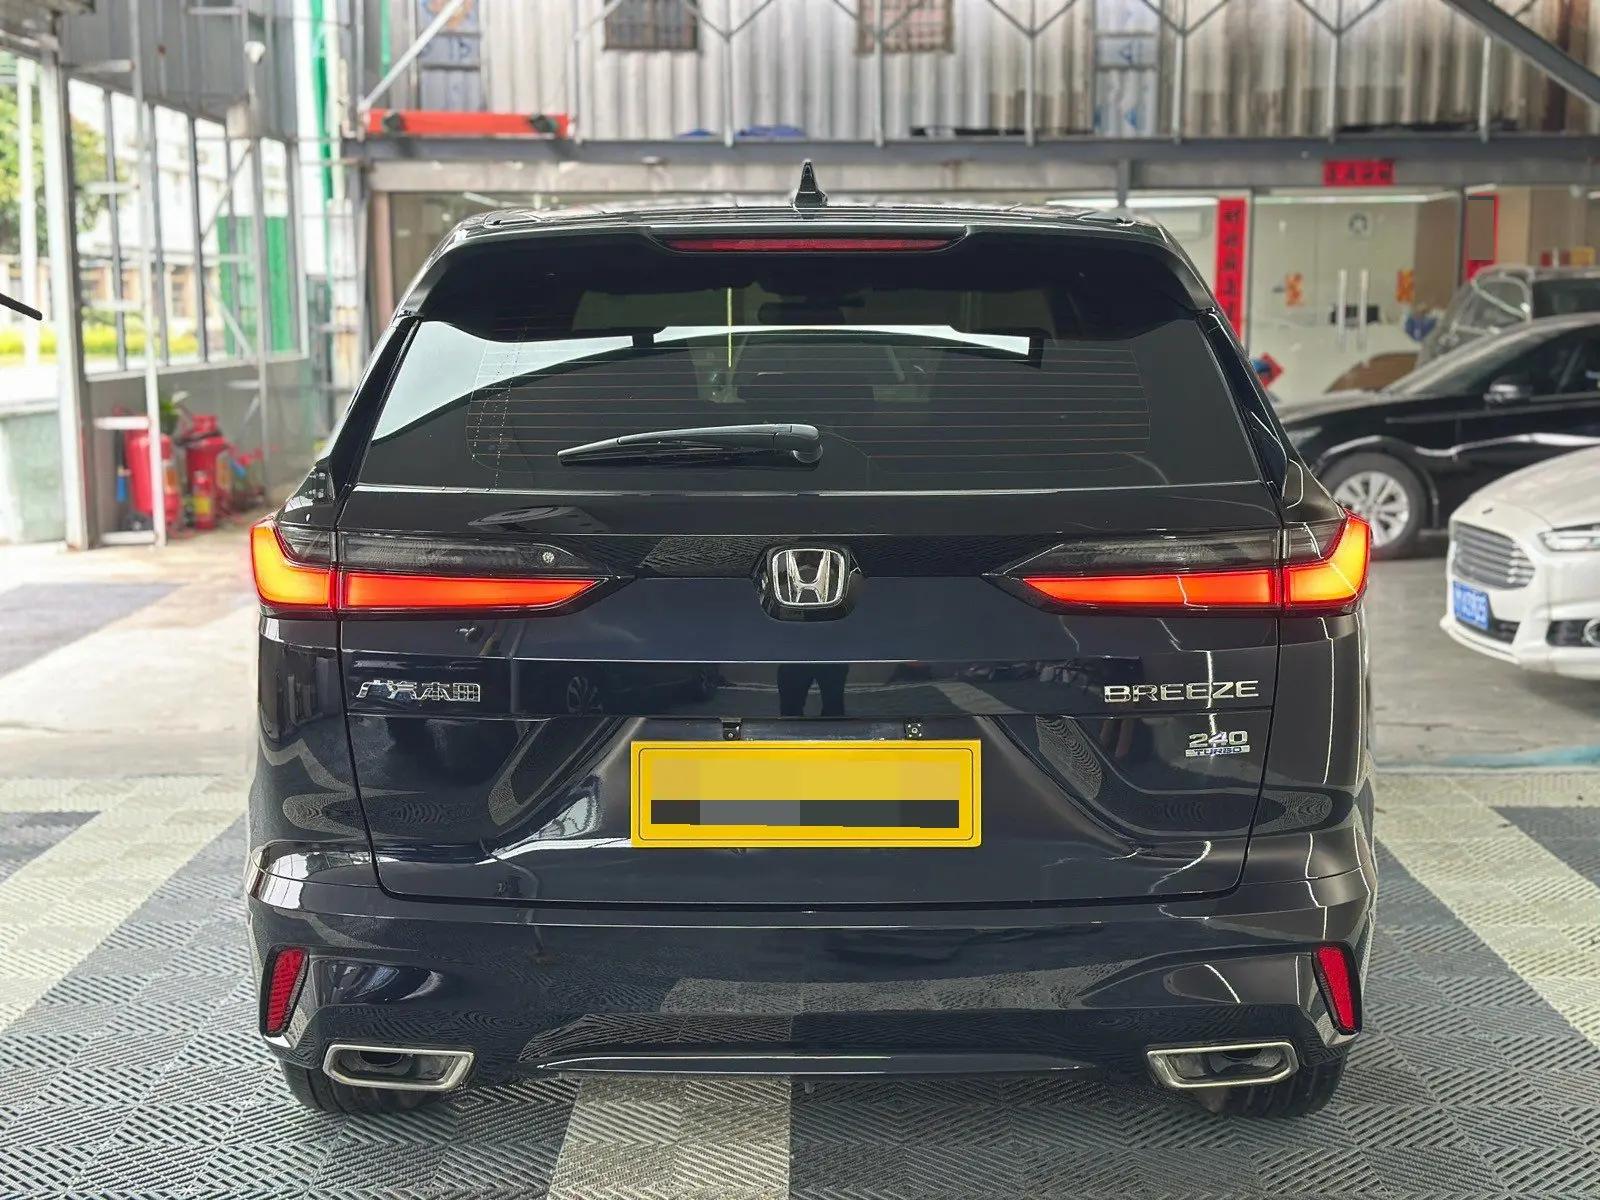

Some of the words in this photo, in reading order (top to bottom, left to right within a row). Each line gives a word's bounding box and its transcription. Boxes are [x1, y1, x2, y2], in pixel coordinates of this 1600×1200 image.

[1104, 680, 1259, 703] BREEZE
[1189, 730, 1248, 748] 240
[1192, 746, 1244, 757] TURBO
